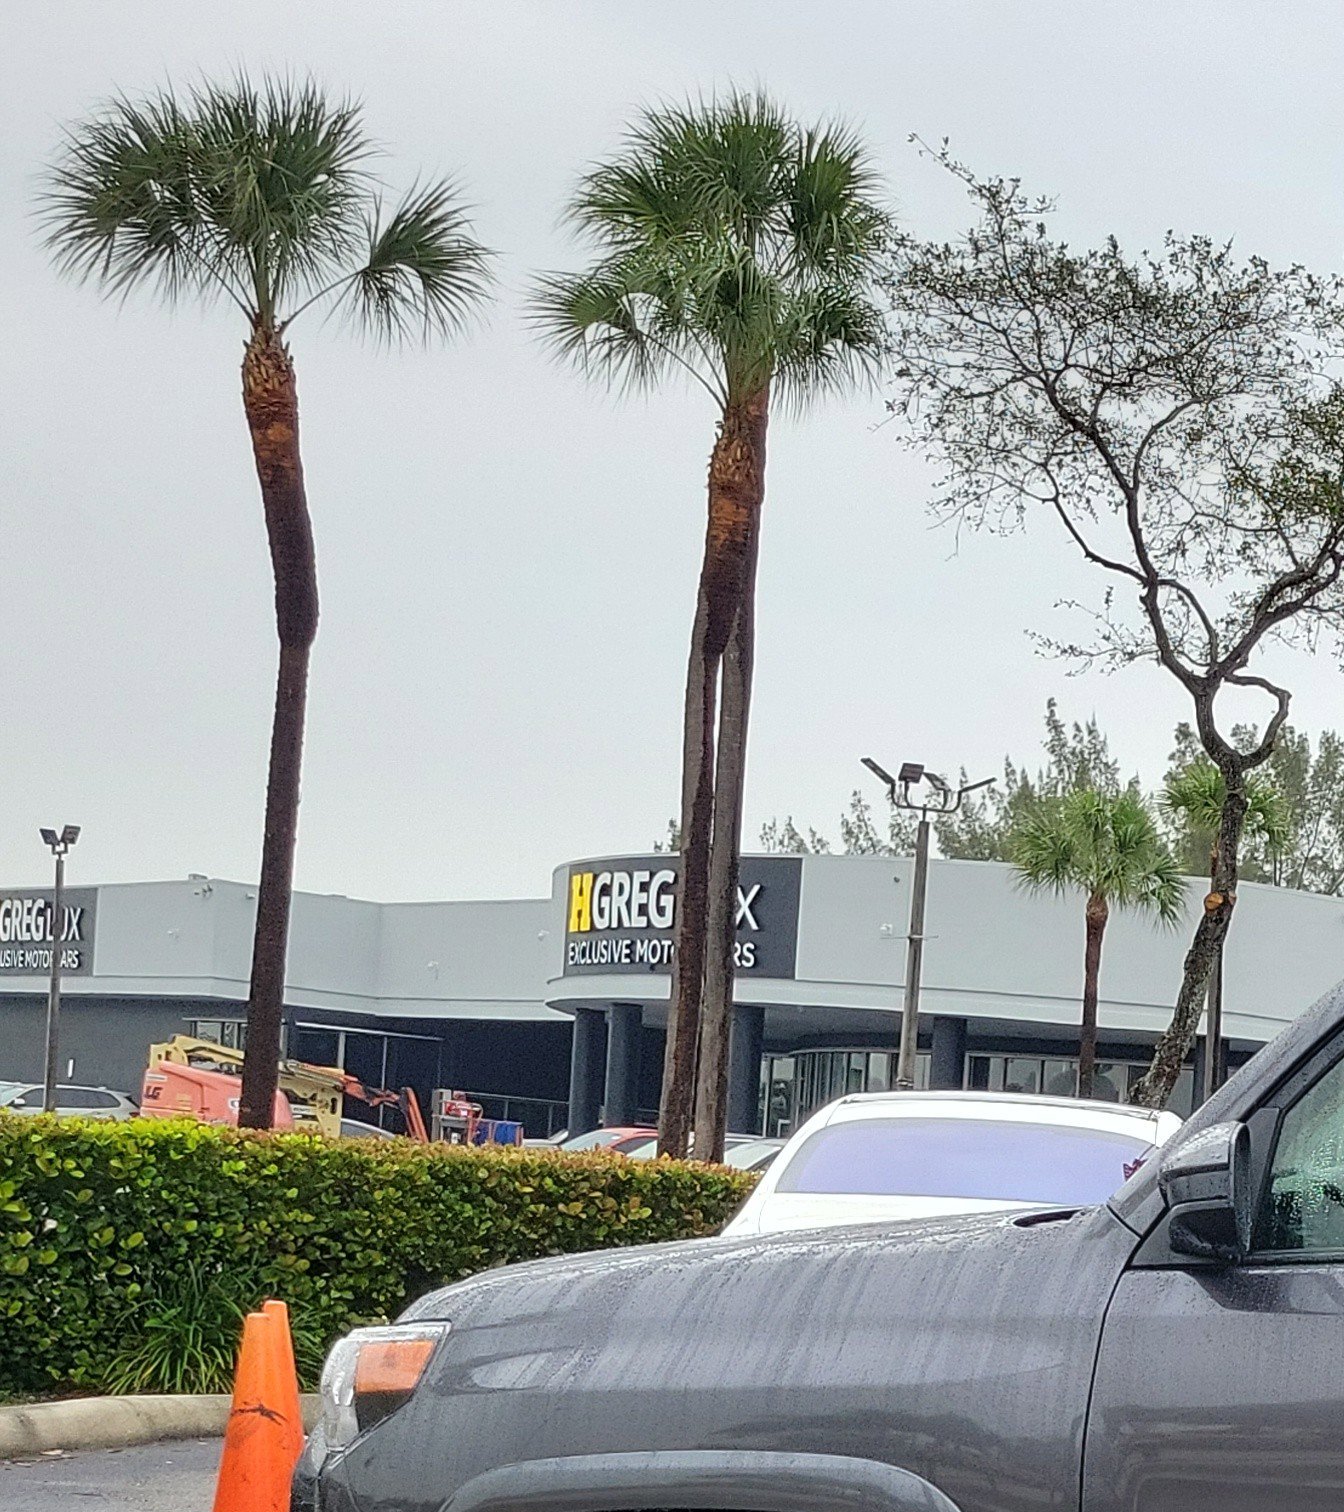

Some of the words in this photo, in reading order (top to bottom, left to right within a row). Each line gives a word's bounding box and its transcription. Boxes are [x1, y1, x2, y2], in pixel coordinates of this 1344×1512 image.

[24, 948, 53, 969] MOTO
[59, 949, 80, 969] ARS
[568, 939, 631, 965] EXCLUSIVE
[635, 939, 675, 964] MOT
